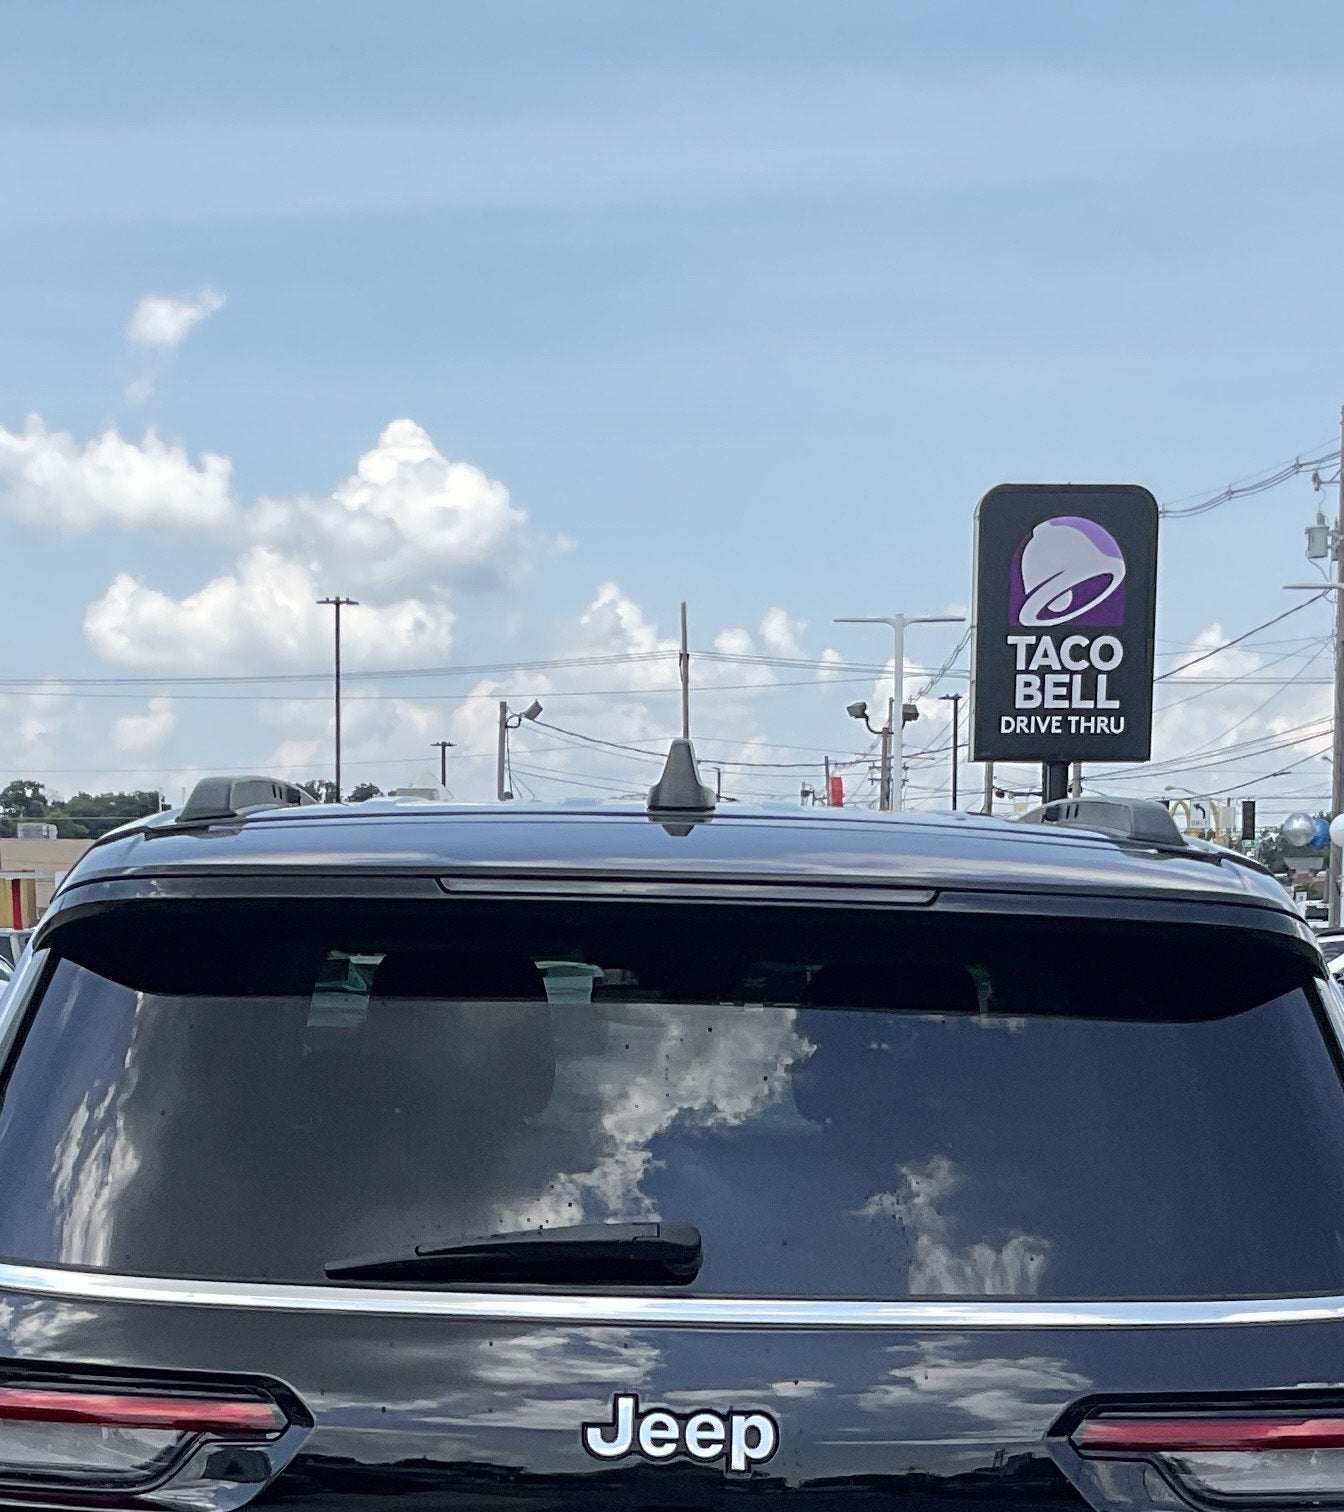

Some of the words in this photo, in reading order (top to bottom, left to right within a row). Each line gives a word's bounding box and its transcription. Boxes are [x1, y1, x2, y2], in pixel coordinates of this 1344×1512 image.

[1007, 635, 1124, 672] TACO
[1014, 673, 1120, 709] BELL
[1000, 715, 1063, 734] DRIVE
[1067, 715, 1125, 735] THRU
[586, 1396, 775, 1472] Jeep
